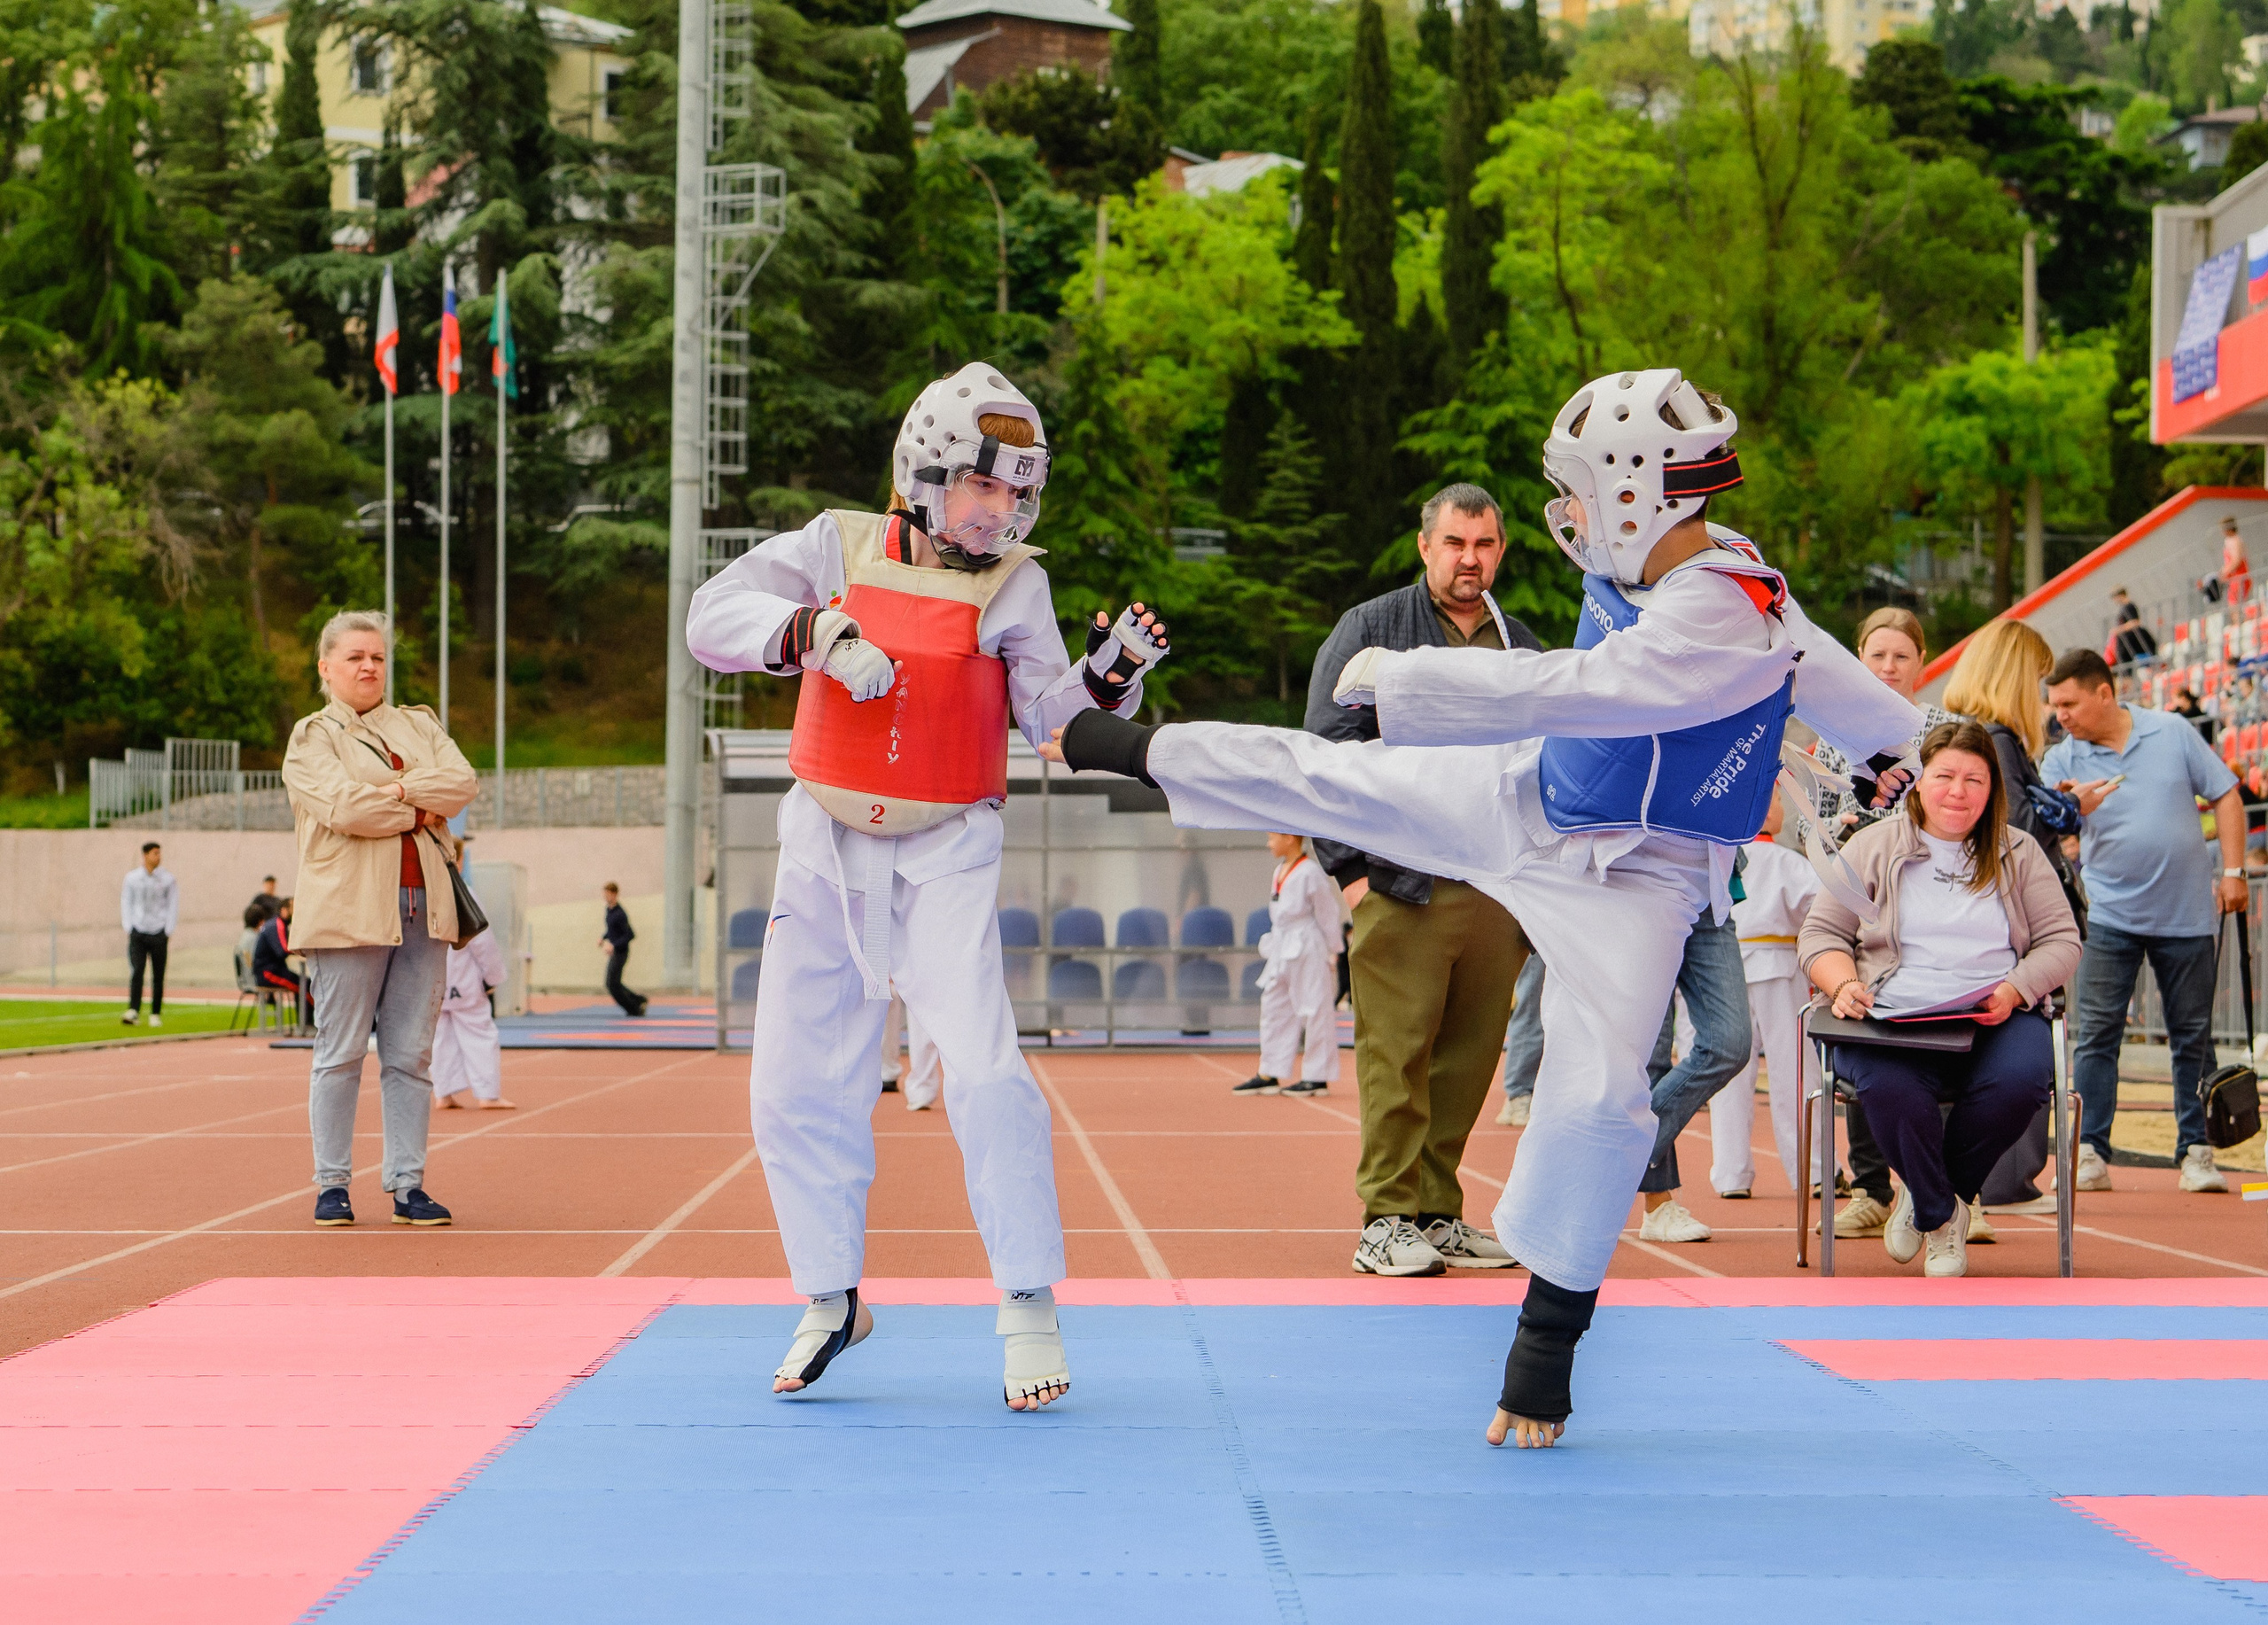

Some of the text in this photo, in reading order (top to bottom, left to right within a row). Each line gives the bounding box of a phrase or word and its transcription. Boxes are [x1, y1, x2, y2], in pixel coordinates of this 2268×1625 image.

[1690, 737, 1745, 807] OF MARTIAL ARTIST
[1708, 723, 1767, 799] The Pride
[869, 804, 886, 825] 2
